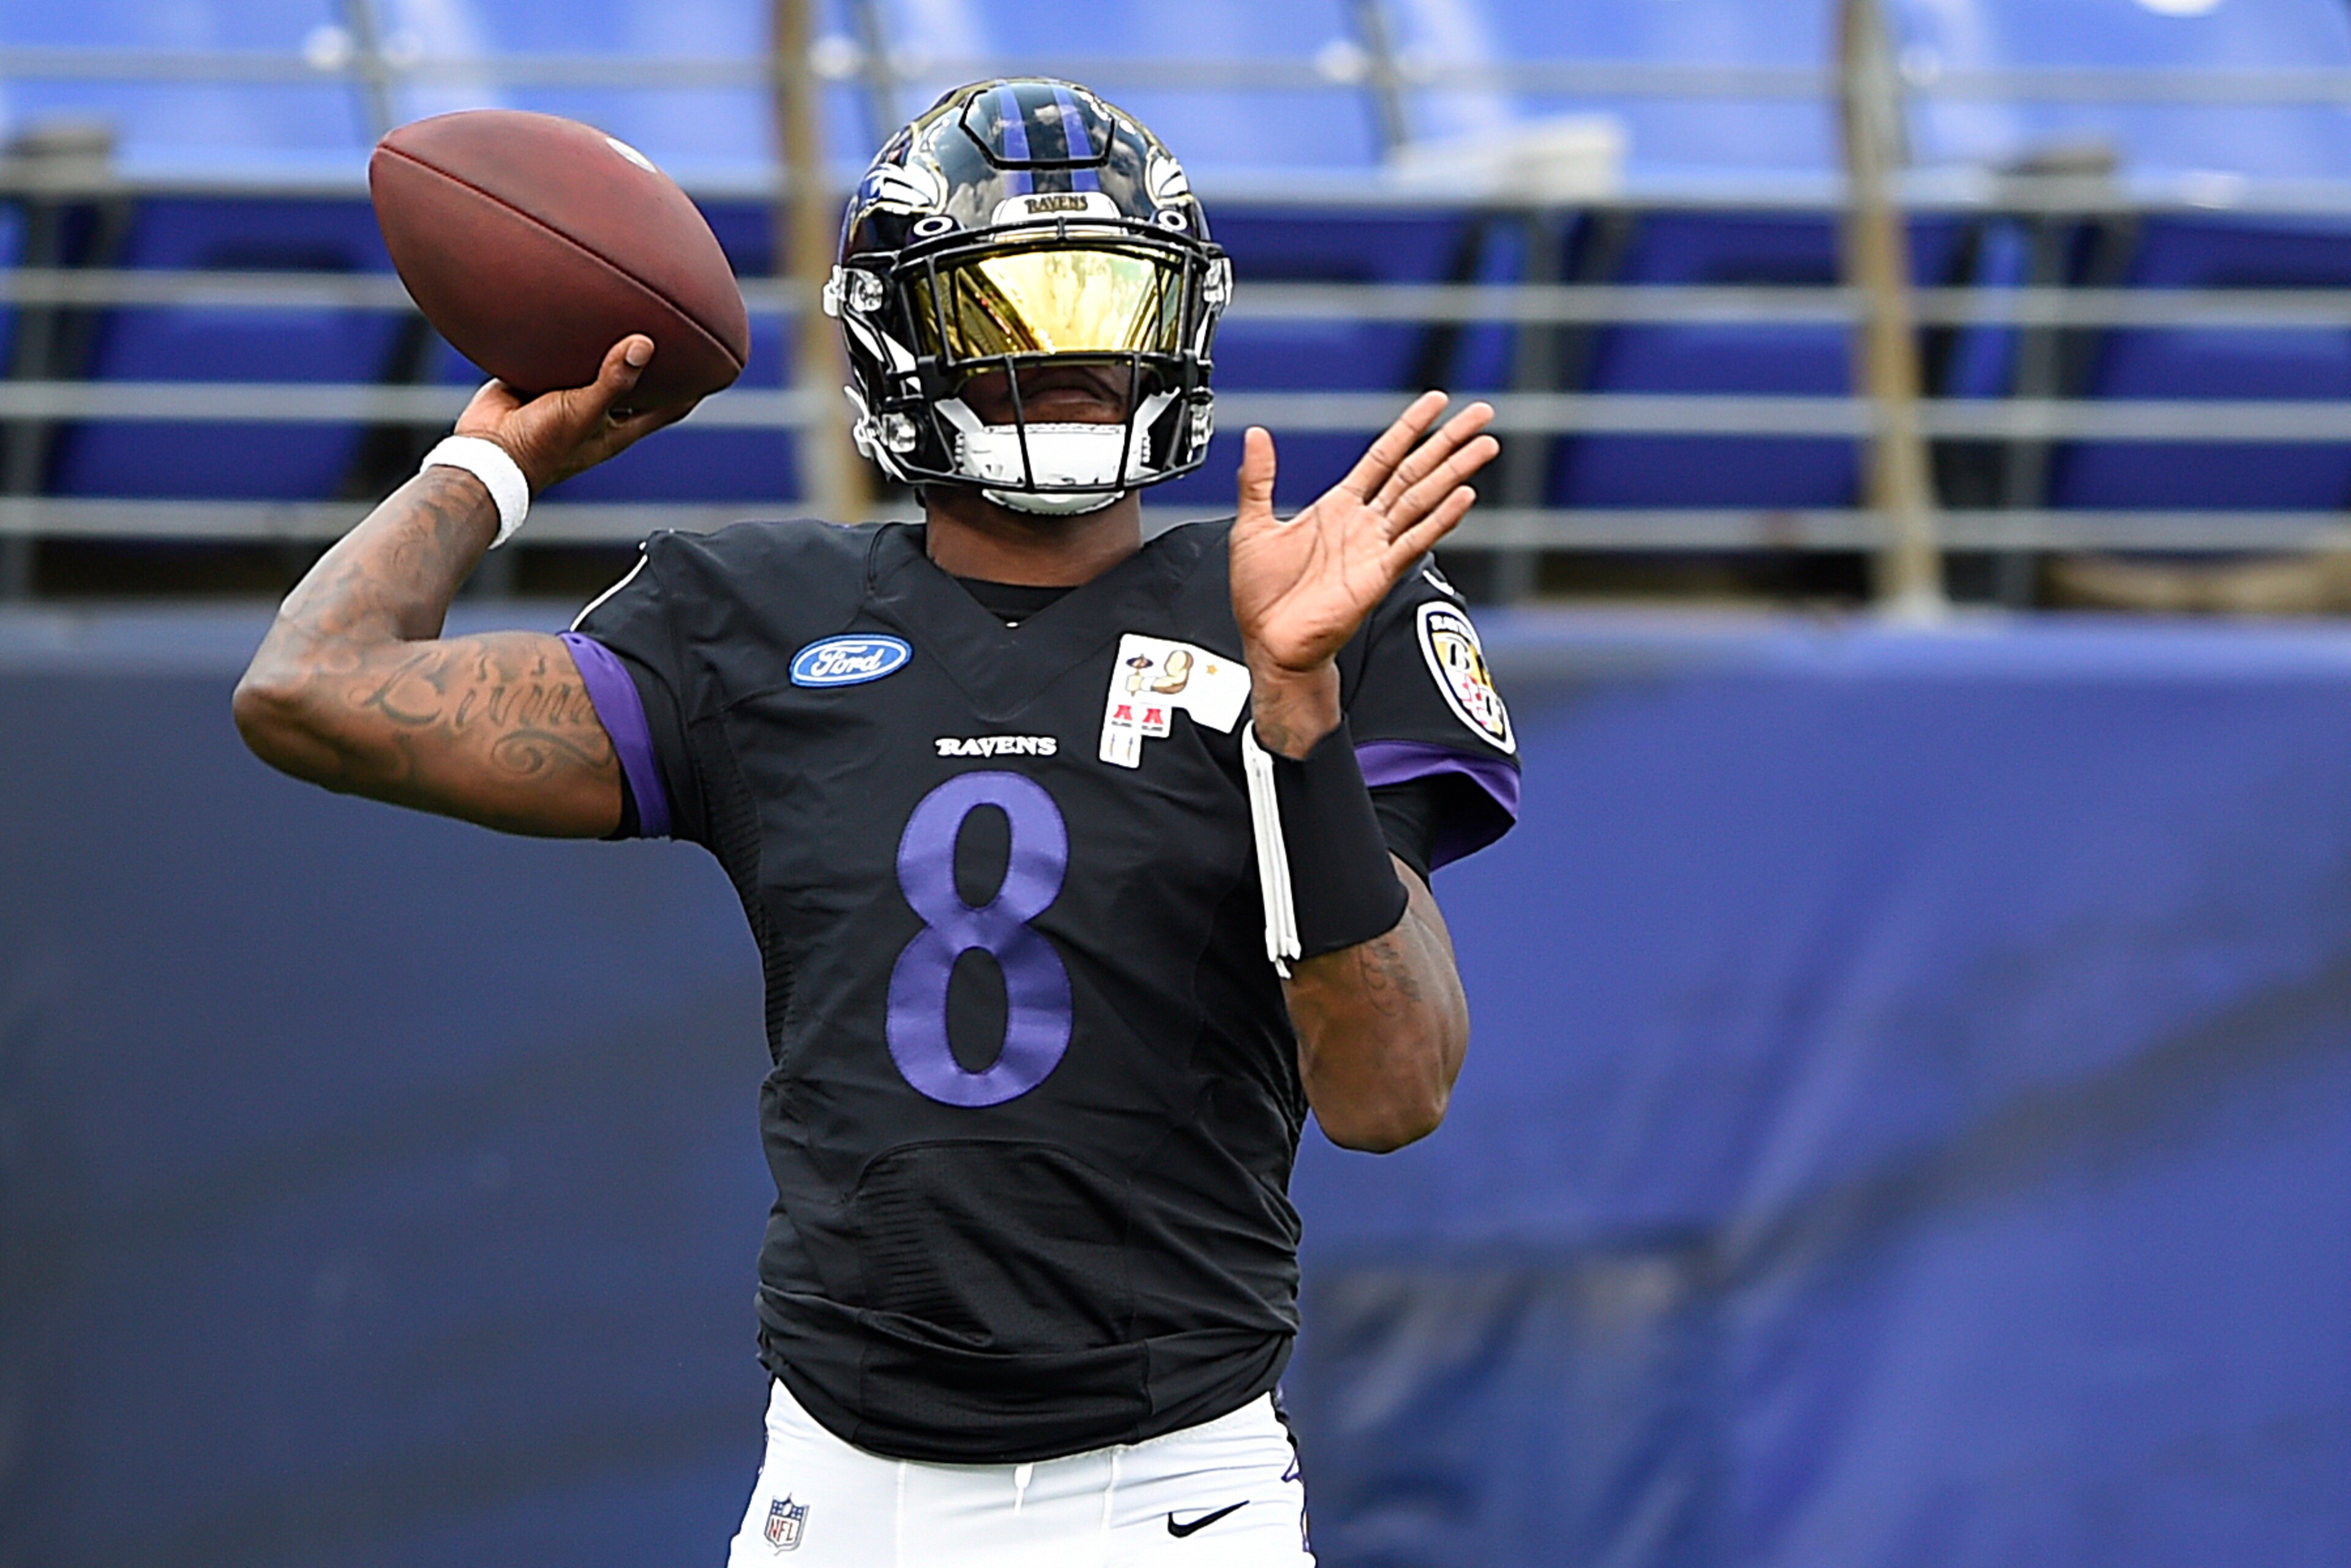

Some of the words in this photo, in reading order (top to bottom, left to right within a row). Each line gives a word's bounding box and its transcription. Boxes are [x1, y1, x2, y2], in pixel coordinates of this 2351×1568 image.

[1024, 195, 1089, 214] RAVENS
[811, 645, 885, 677] Ford
[935, 736, 1057, 757] RAVENS
[887, 770, 1072, 1108] 8
[768, 1518, 793, 1542] NFL
